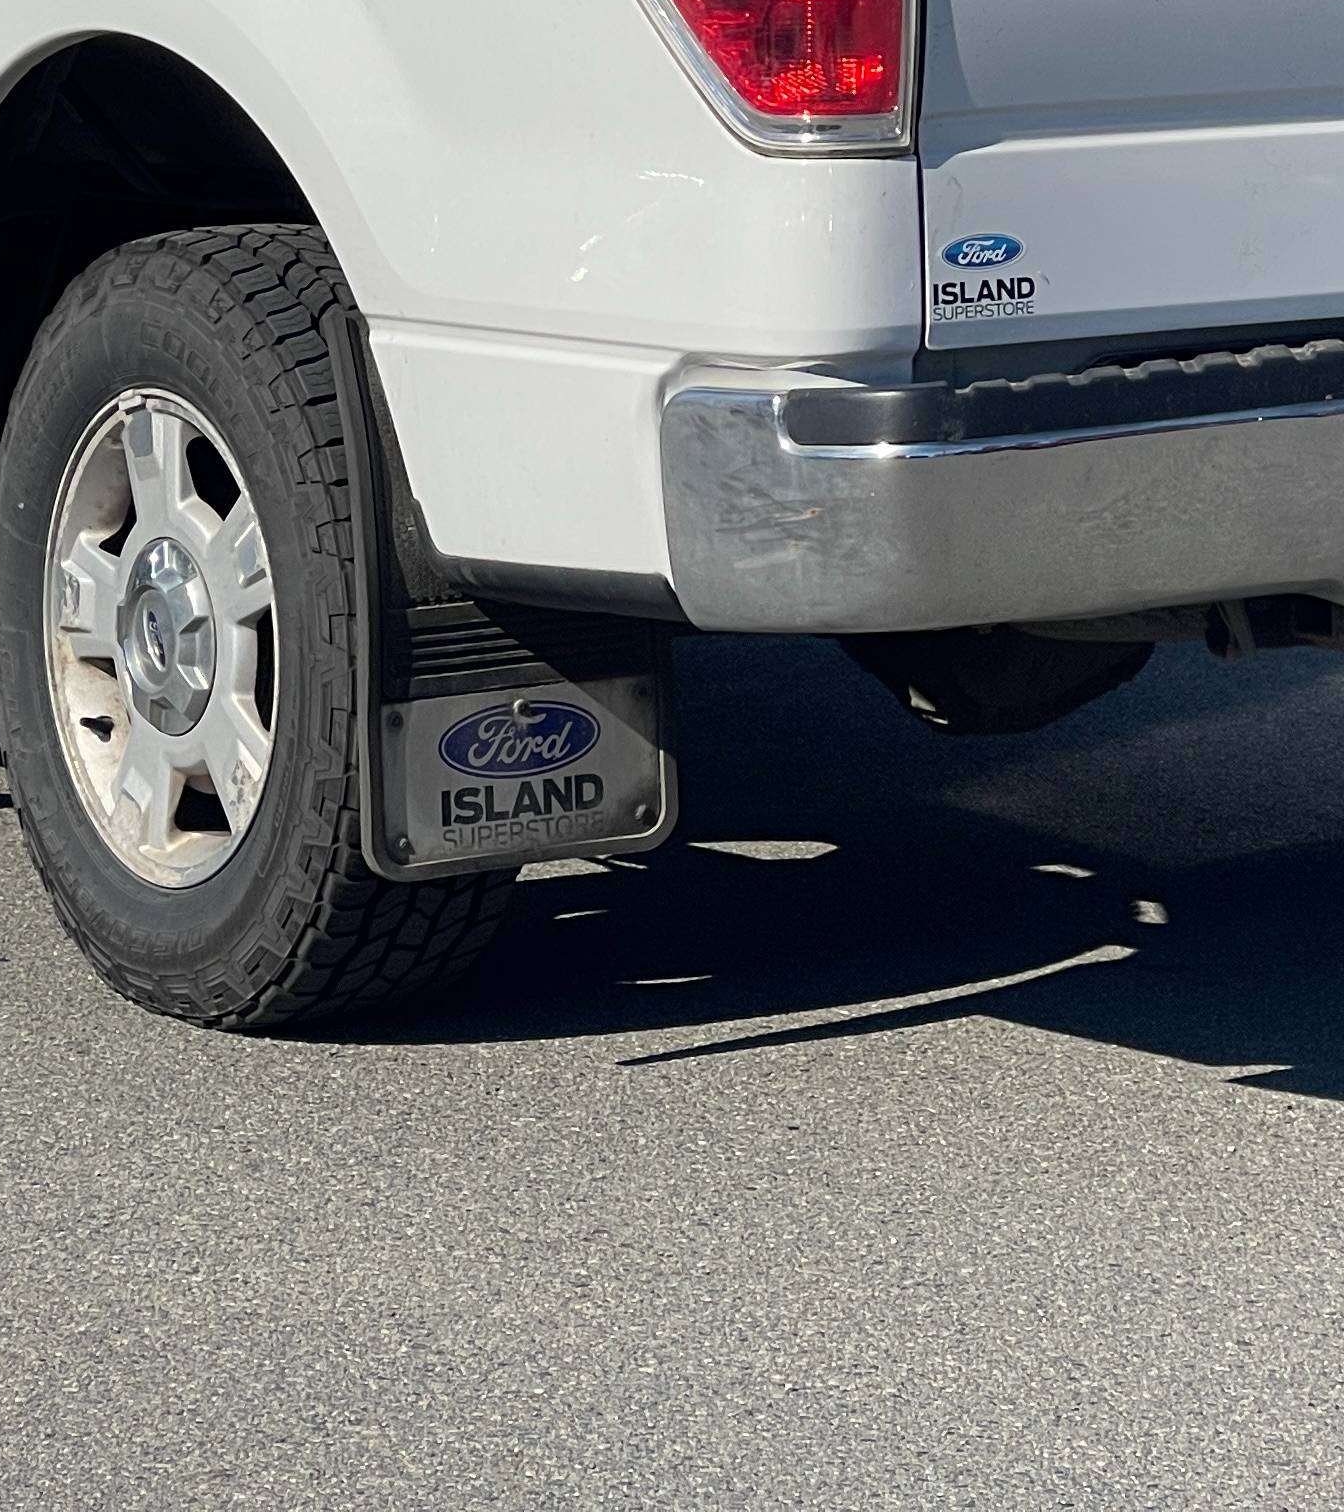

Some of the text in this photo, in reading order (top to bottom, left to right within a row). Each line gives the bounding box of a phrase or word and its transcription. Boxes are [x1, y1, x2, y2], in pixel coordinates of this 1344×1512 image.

[957, 239, 1007, 265] Ford
[933, 277, 1035, 306] ISLAND
[933, 300, 1035, 321] SUPERSTORE
[467, 714, 573, 768] Ford
[441, 773, 604, 827] ISLAND
